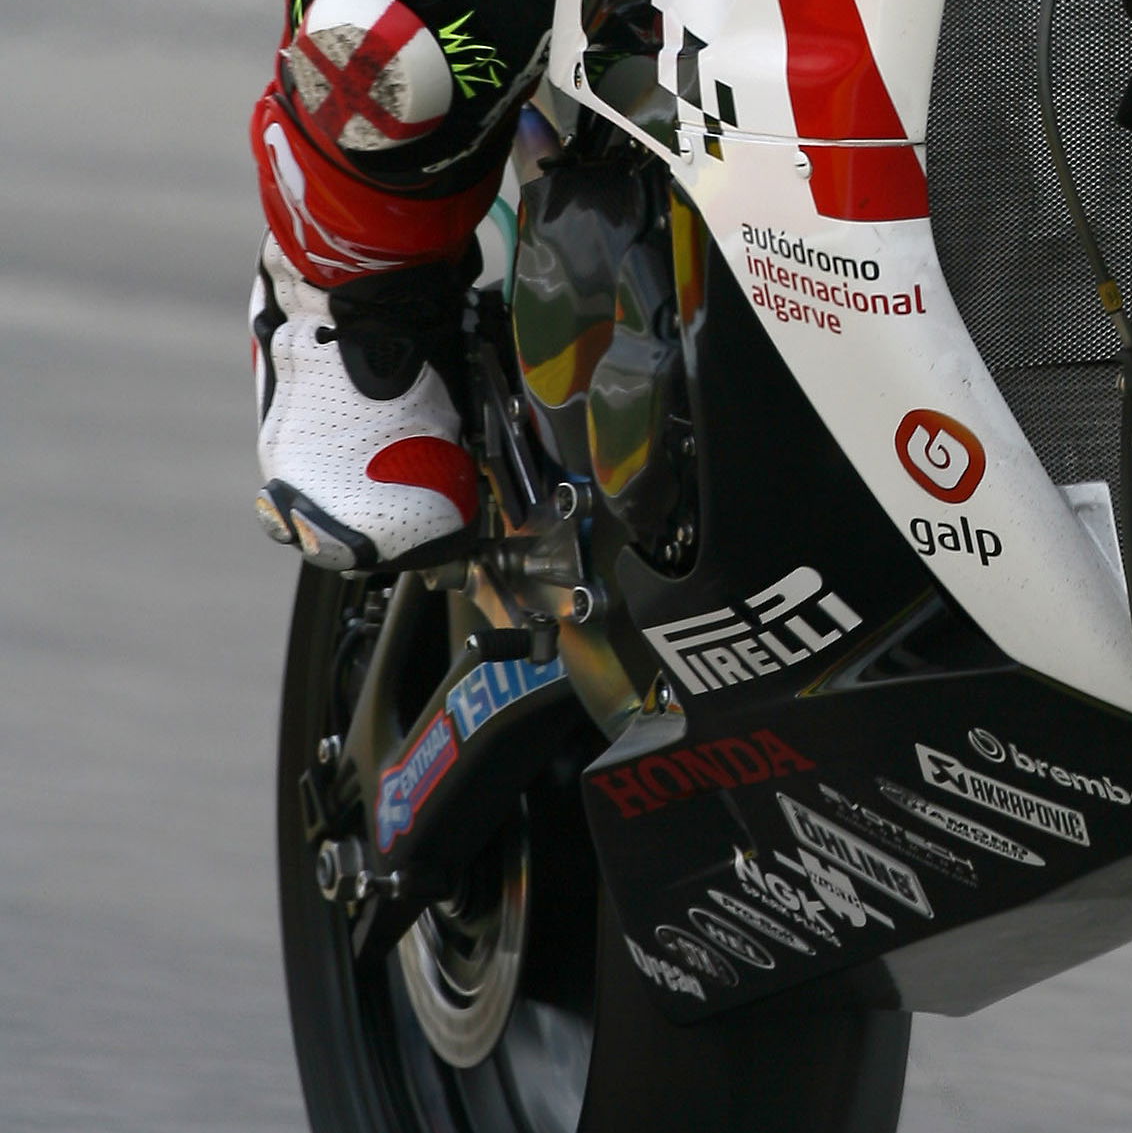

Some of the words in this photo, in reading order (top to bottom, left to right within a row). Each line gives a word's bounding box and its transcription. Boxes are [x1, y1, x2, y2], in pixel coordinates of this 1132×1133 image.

[741, 222, 880, 282] autódromo
[745, 247, 927, 316] internacional
[752, 283, 843, 334] algarve
[909, 516, 1003, 567] galp
[641, 566, 863, 696] PIRELLI
[592, 728, 817, 819] HONDA
[732, 844, 838, 934] NGK
